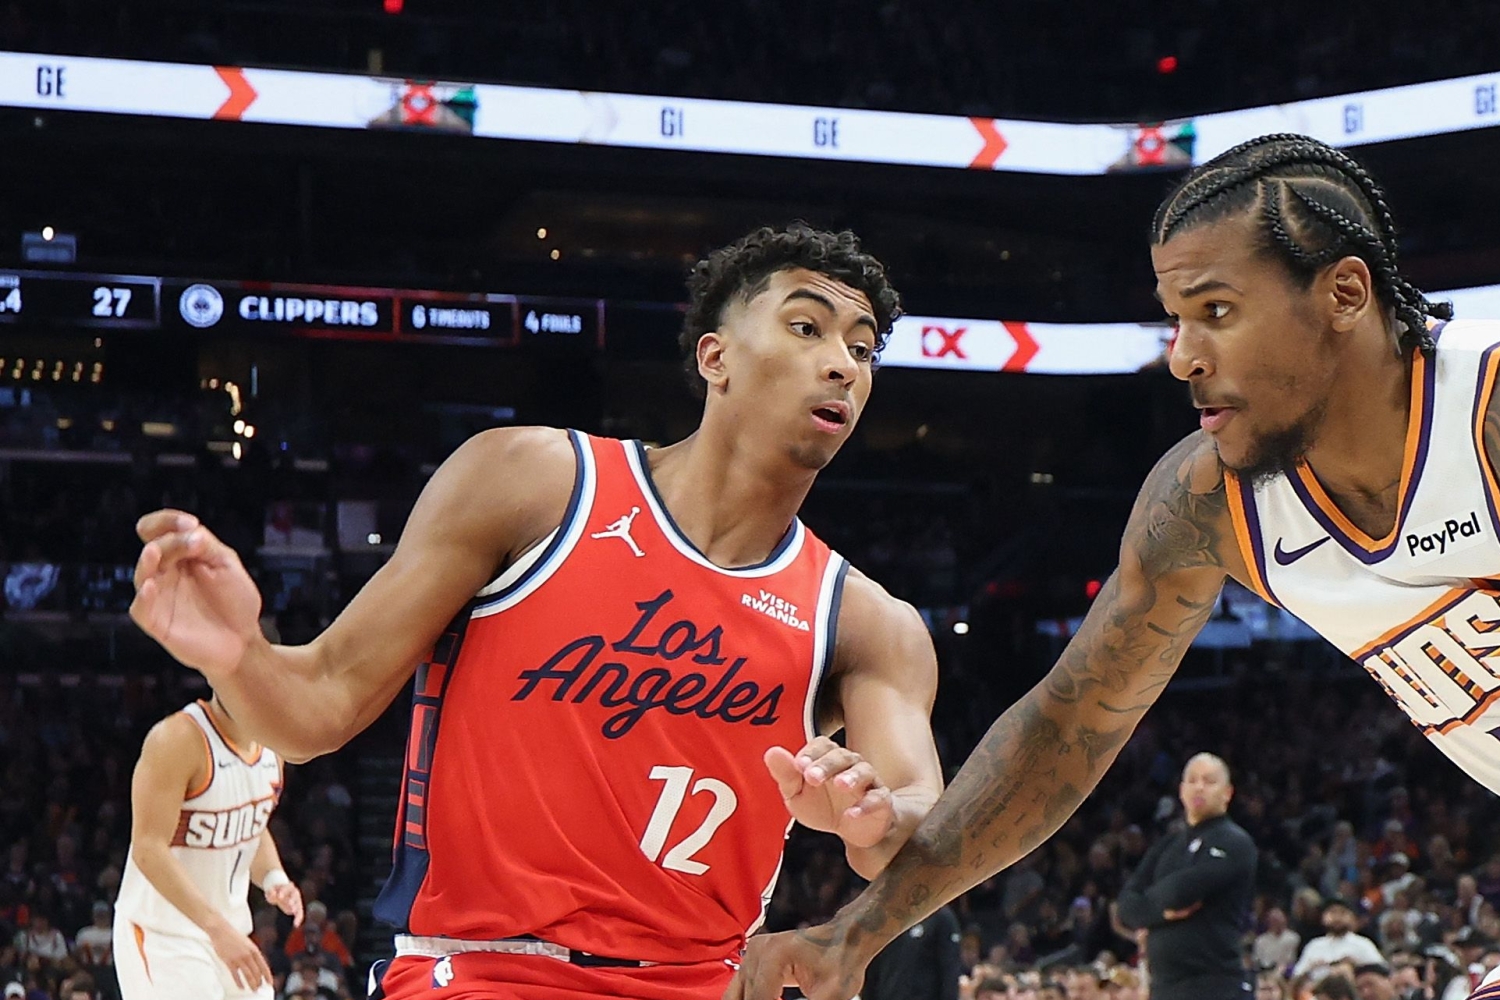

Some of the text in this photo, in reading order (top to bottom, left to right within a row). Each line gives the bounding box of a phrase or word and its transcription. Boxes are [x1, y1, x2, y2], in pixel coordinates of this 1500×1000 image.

[92, 287, 132, 318] 27
[239, 295, 379, 327] CLIPPERS
[412, 304, 426, 329] 6
[524, 310, 540, 335] 4
[1406, 510, 1482, 557] PayPal
[741, 593, 811, 632] RWANDA
[759, 589, 798, 616] VISIT
[611, 588, 728, 666] Los
[510, 634, 785, 740] Angeles
[638, 764, 738, 876] 12
[228, 849, 243, 895] 1
